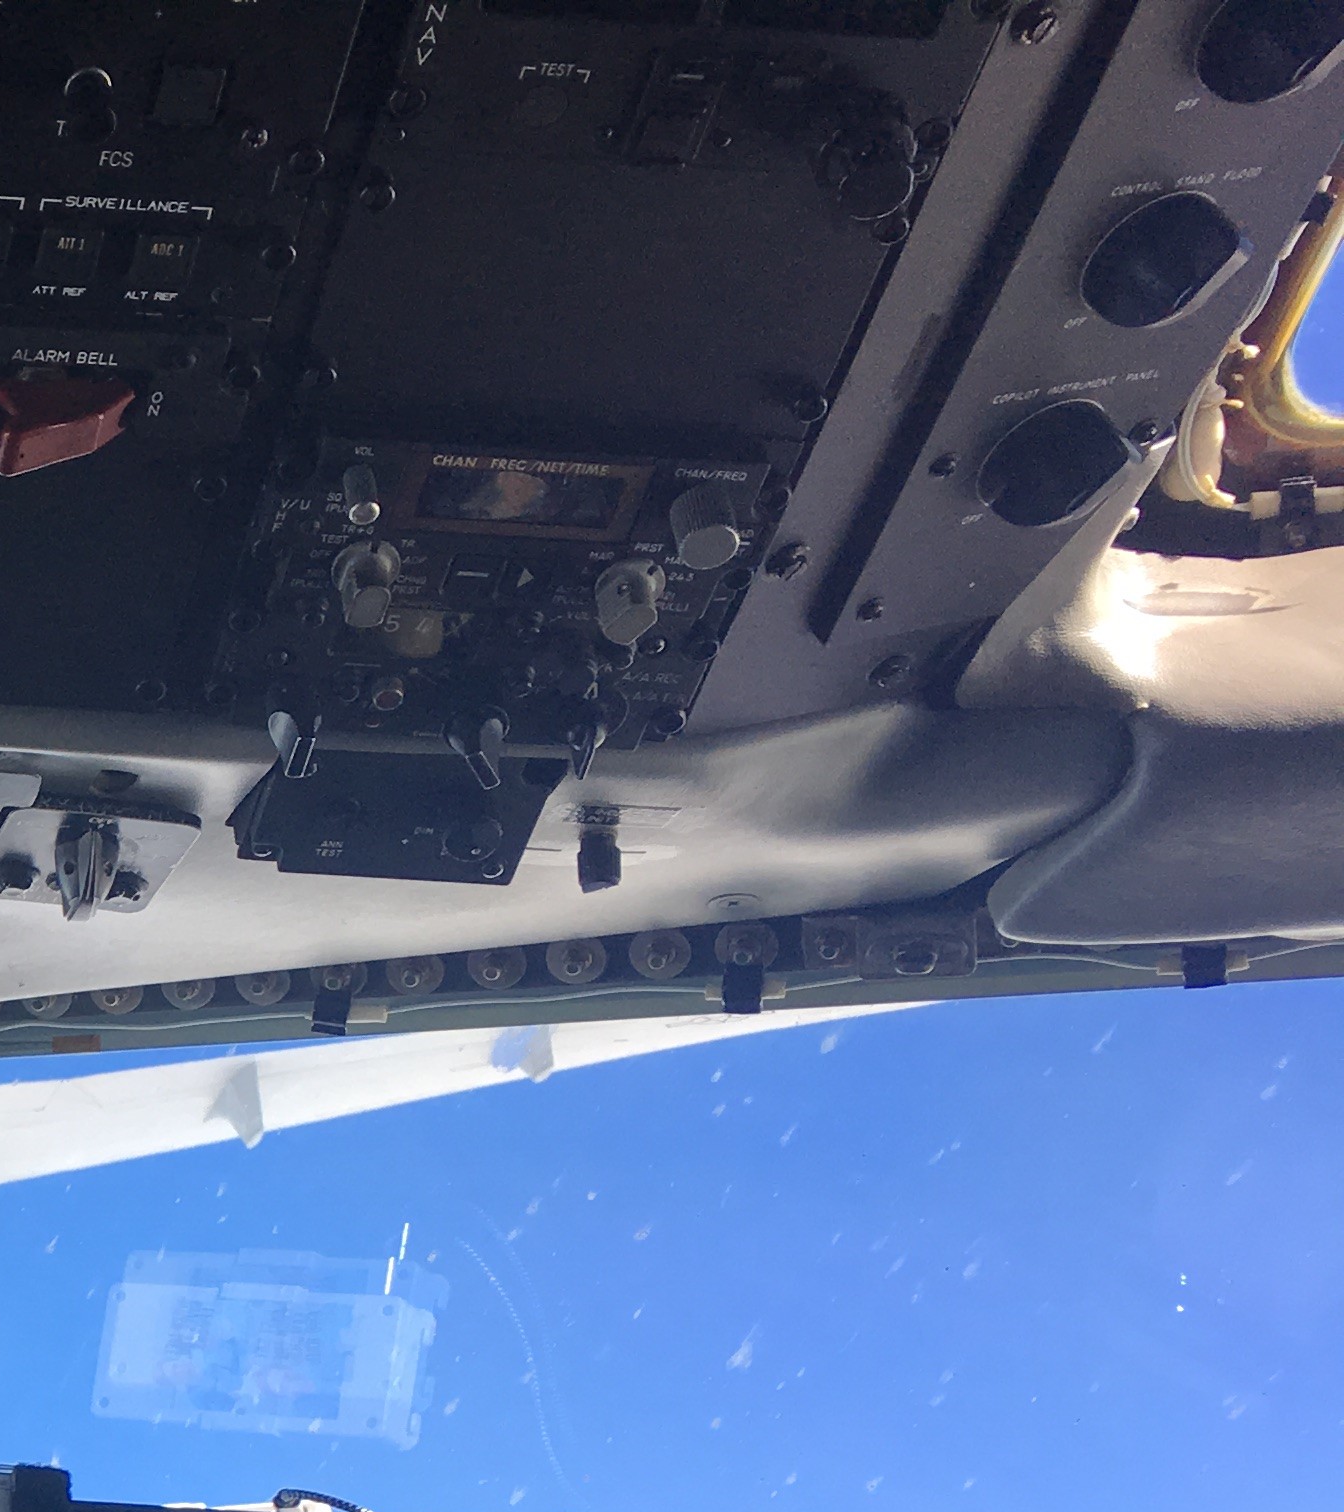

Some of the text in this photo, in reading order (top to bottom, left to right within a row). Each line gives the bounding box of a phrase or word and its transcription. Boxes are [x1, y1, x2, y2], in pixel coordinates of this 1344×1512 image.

[540, 62, 576, 78] TEST
[99, 151, 134, 168] FCS
[1111, 166, 1263, 197] CONTROL STAND FLOOD
[65, 196, 189, 214] SURVEILLANCE
[32, 285, 87, 297] ATT REF
[124, 290, 178, 302] ALT REF
[12, 348, 118, 366] ALARM BELL
[993, 369, 1160, 405] COPILOT INSTRUMENT PANEL
[355, 447, 375, 457] VOL
[433, 455, 478, 469] CHAN
[674, 467, 747, 483] CHAN/FREQ
[321, 534, 349, 544] TEST
[634, 543, 664, 553] PRST
